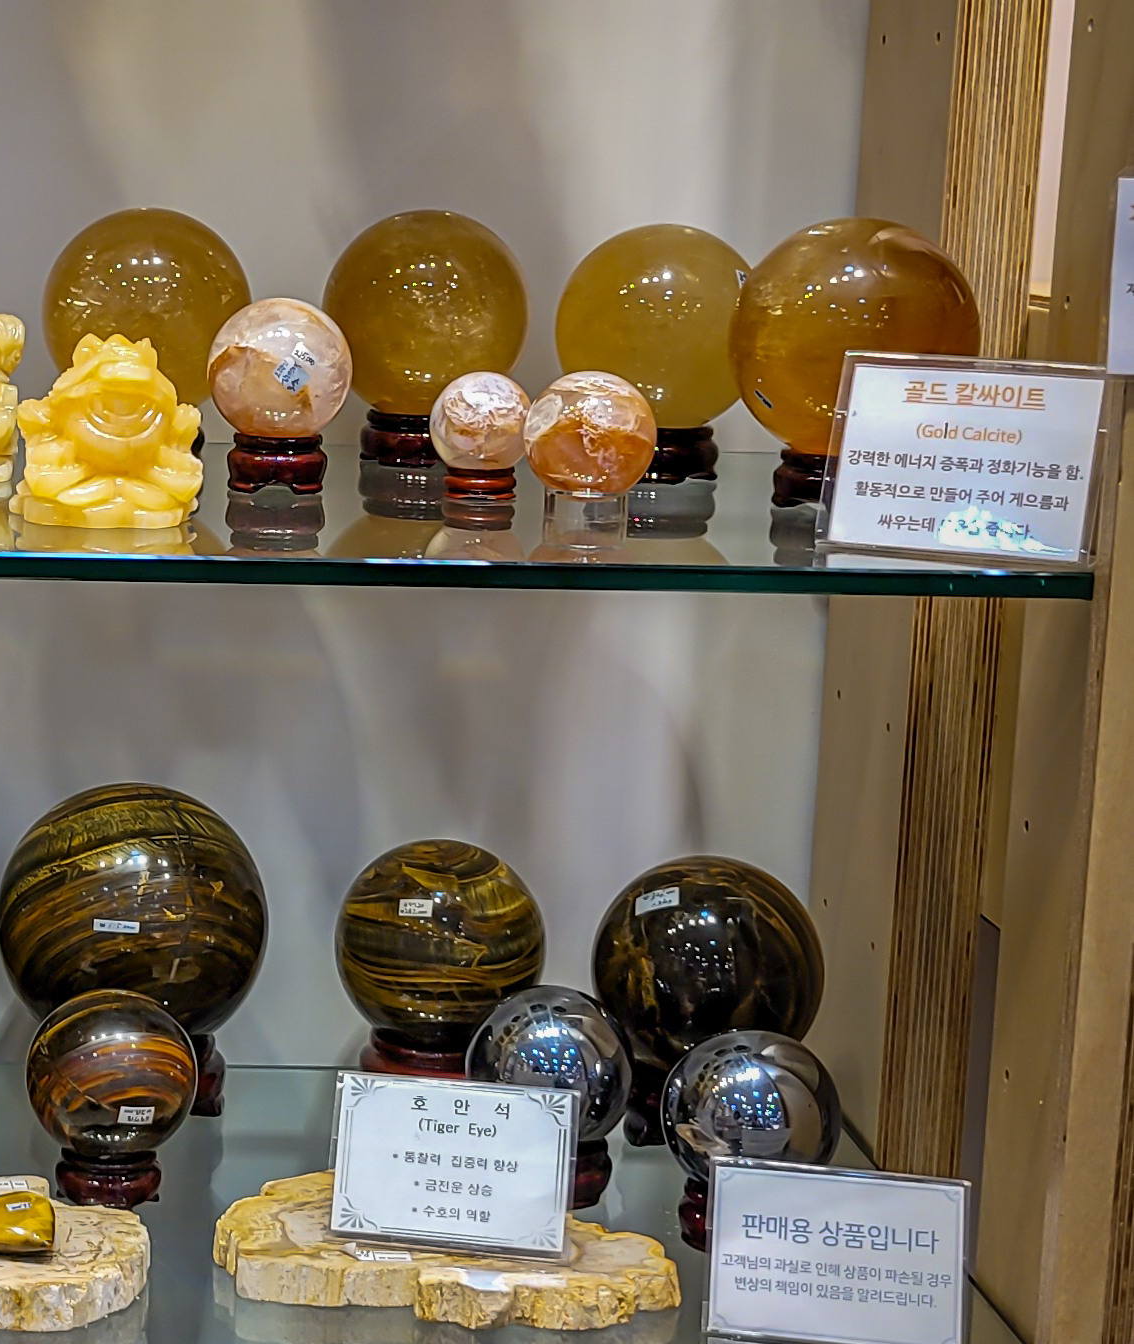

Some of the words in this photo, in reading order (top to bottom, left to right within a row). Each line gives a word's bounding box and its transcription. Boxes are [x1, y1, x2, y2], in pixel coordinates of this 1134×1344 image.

[904, 380, 947, 403] 골드
[955, 382, 1045, 407] 칼싸이트
[916, 422, 958, 440] (Gold
[962, 425, 1022, 444] Calcite)
[848, 450, 890, 468] 강력한
[894, 453, 935, 471] 에너지
[940, 455, 983, 474] 증폭과
[987, 458, 1061, 479] 정화기능을
[1065, 465, 1084, 480] 함.
[855, 481, 925, 500] 활동적으로
[930, 485, 972, 503] 만들어
[976, 489, 1005, 506] 주어
[1009, 492, 1070, 511] 게으름과
[878, 514, 934, 533] 싸우는데
[410, 1095, 428, 1111] 호
[454, 1099, 470, 1116] 안
[495, 1102, 510, 1120] 석
[418, 1118, 460, 1135] (Tiger
[468, 1123, 497, 1138] Eye)
[451, 1155, 488, 1171] 집중력
[494, 1159, 518, 1173] 향상
[467, 1182, 493, 1197] 상승
[423, 1205, 460, 1221] 수호의
[466, 1209, 491, 1224] 역할
[742, 1213, 813, 1245] 판매용
[818, 1220, 940, 1255] 상품입니다
[720, 1253, 771, 1271] 고객님의
[774, 1257, 812, 1275] 과실로
[816, 1261, 840, 1278] 인해
[843, 1264, 882, 1282] 상품이
[926, 1273, 953, 1289] 경우
[774, 1279, 813, 1297] 책임이
[816, 1283, 854, 1301] 있음을
[857, 1287, 937, 1308] 알려드립니다.
